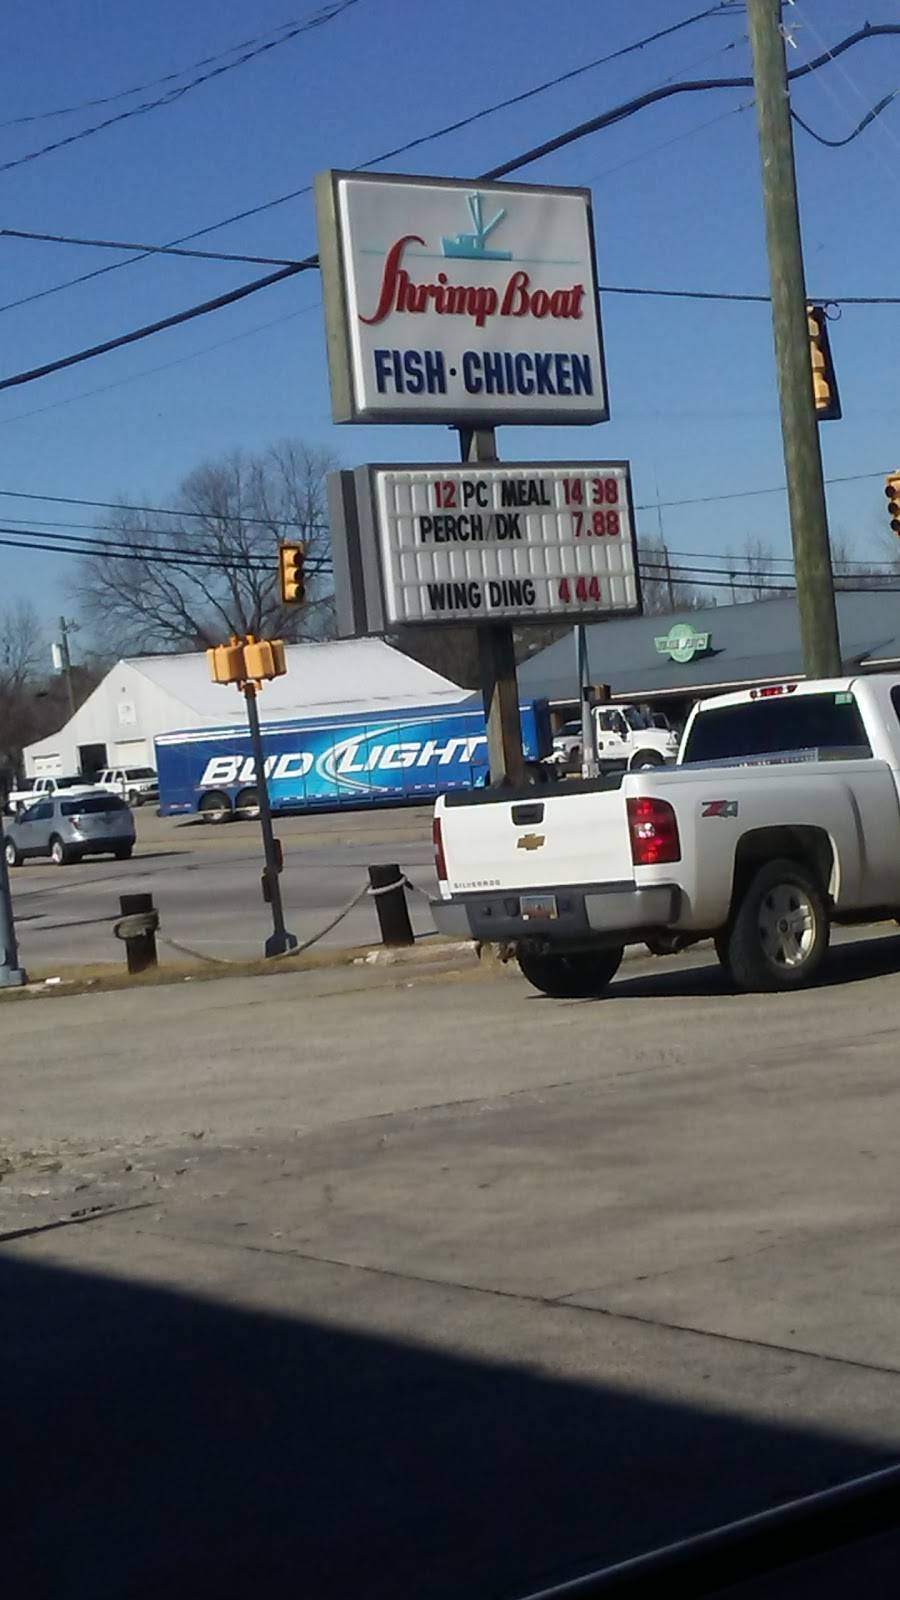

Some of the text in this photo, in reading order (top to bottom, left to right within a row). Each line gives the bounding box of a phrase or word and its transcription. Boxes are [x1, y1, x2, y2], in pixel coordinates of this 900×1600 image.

[358, 235, 586, 327] Shrimp Boat
[374, 350, 593, 396] FISH CHICKEN
[434, 481, 457, 508] 12
[463, 480, 488, 507] PC
[501, 479, 550, 507] MEAL
[572, 511, 619, 537] 7.88
[427, 582, 481, 610] WING
[488, 579, 536, 607] DING
[201, 736, 487, 785] BUD LIGHT
